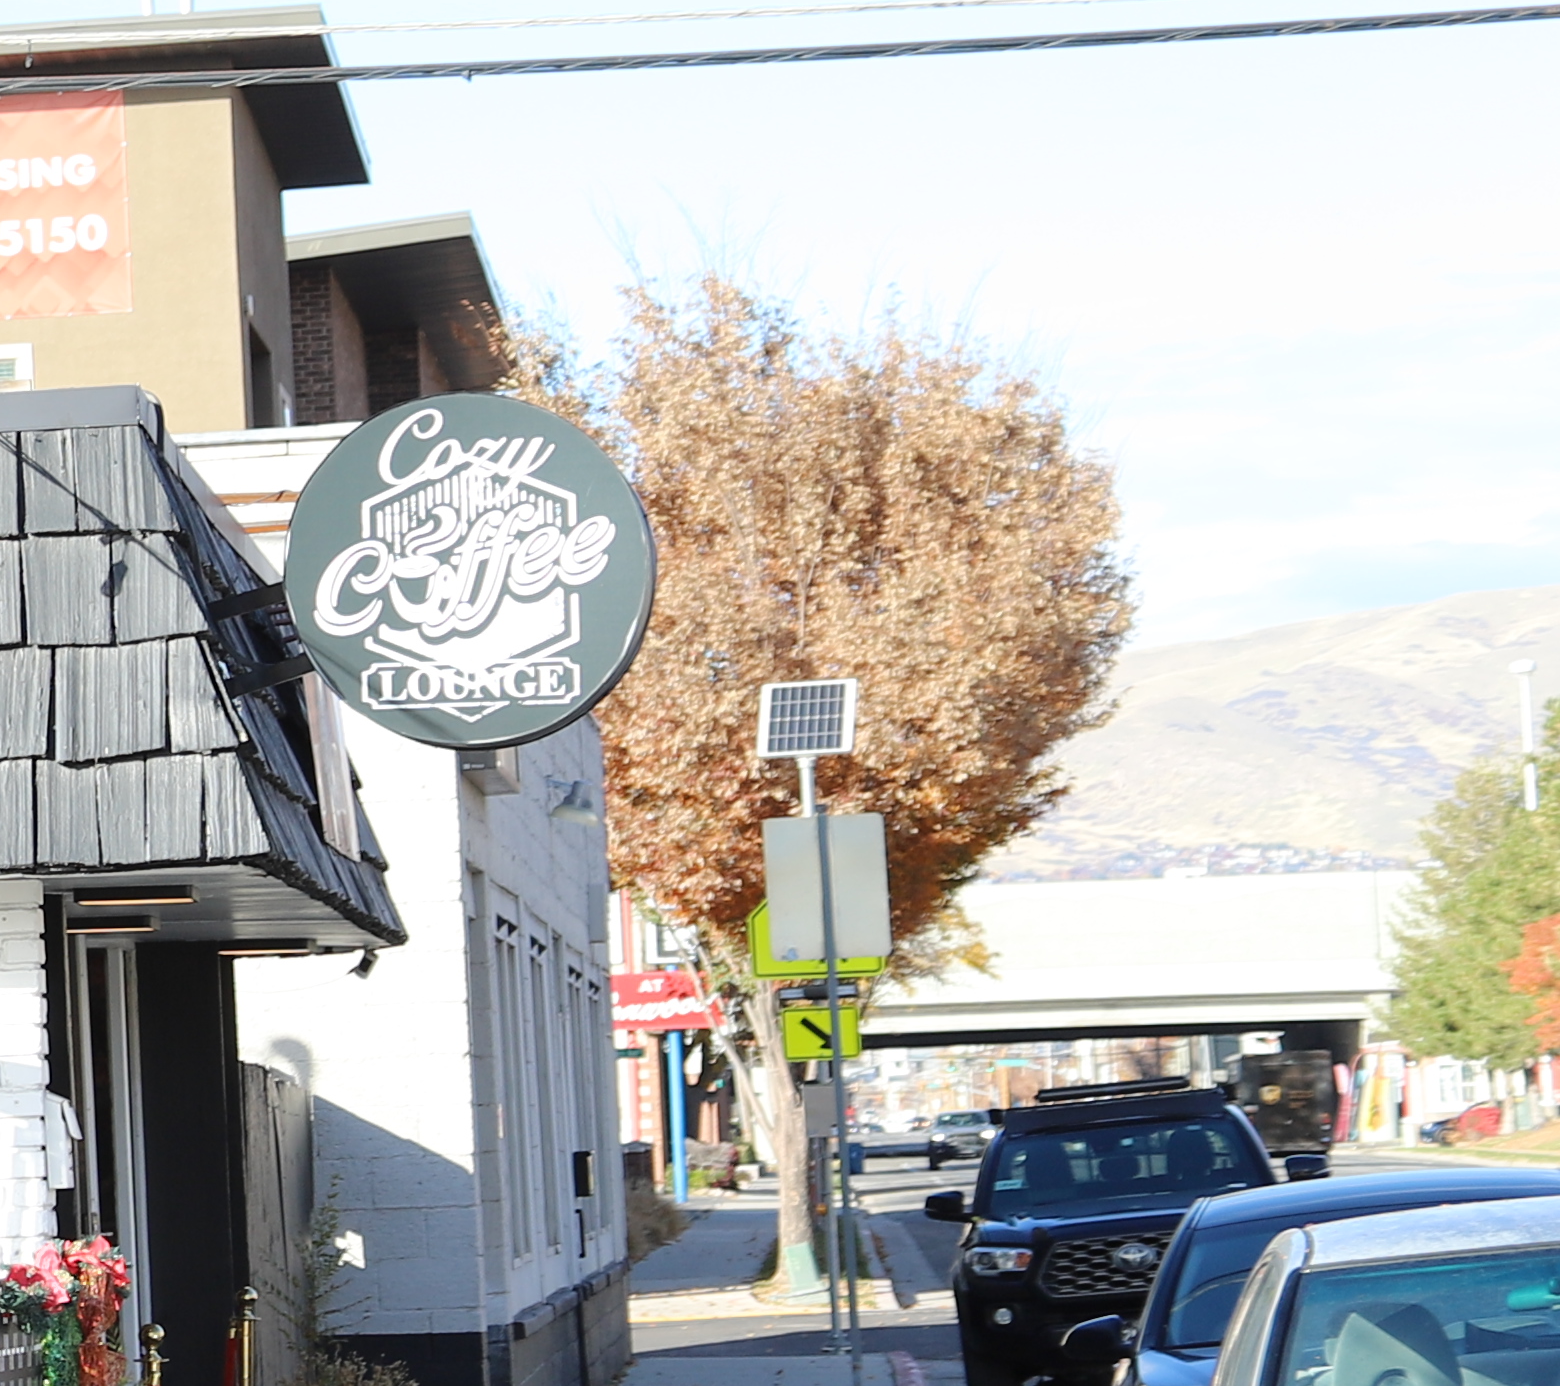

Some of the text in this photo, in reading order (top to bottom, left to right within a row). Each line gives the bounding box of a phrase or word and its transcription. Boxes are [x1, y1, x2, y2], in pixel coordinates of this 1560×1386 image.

[377, 408, 557, 507] Cozy
[313, 502, 617, 639] Coffee
[378, 664, 569, 703] LOUNGE
[637, 977, 665, 994] AT
